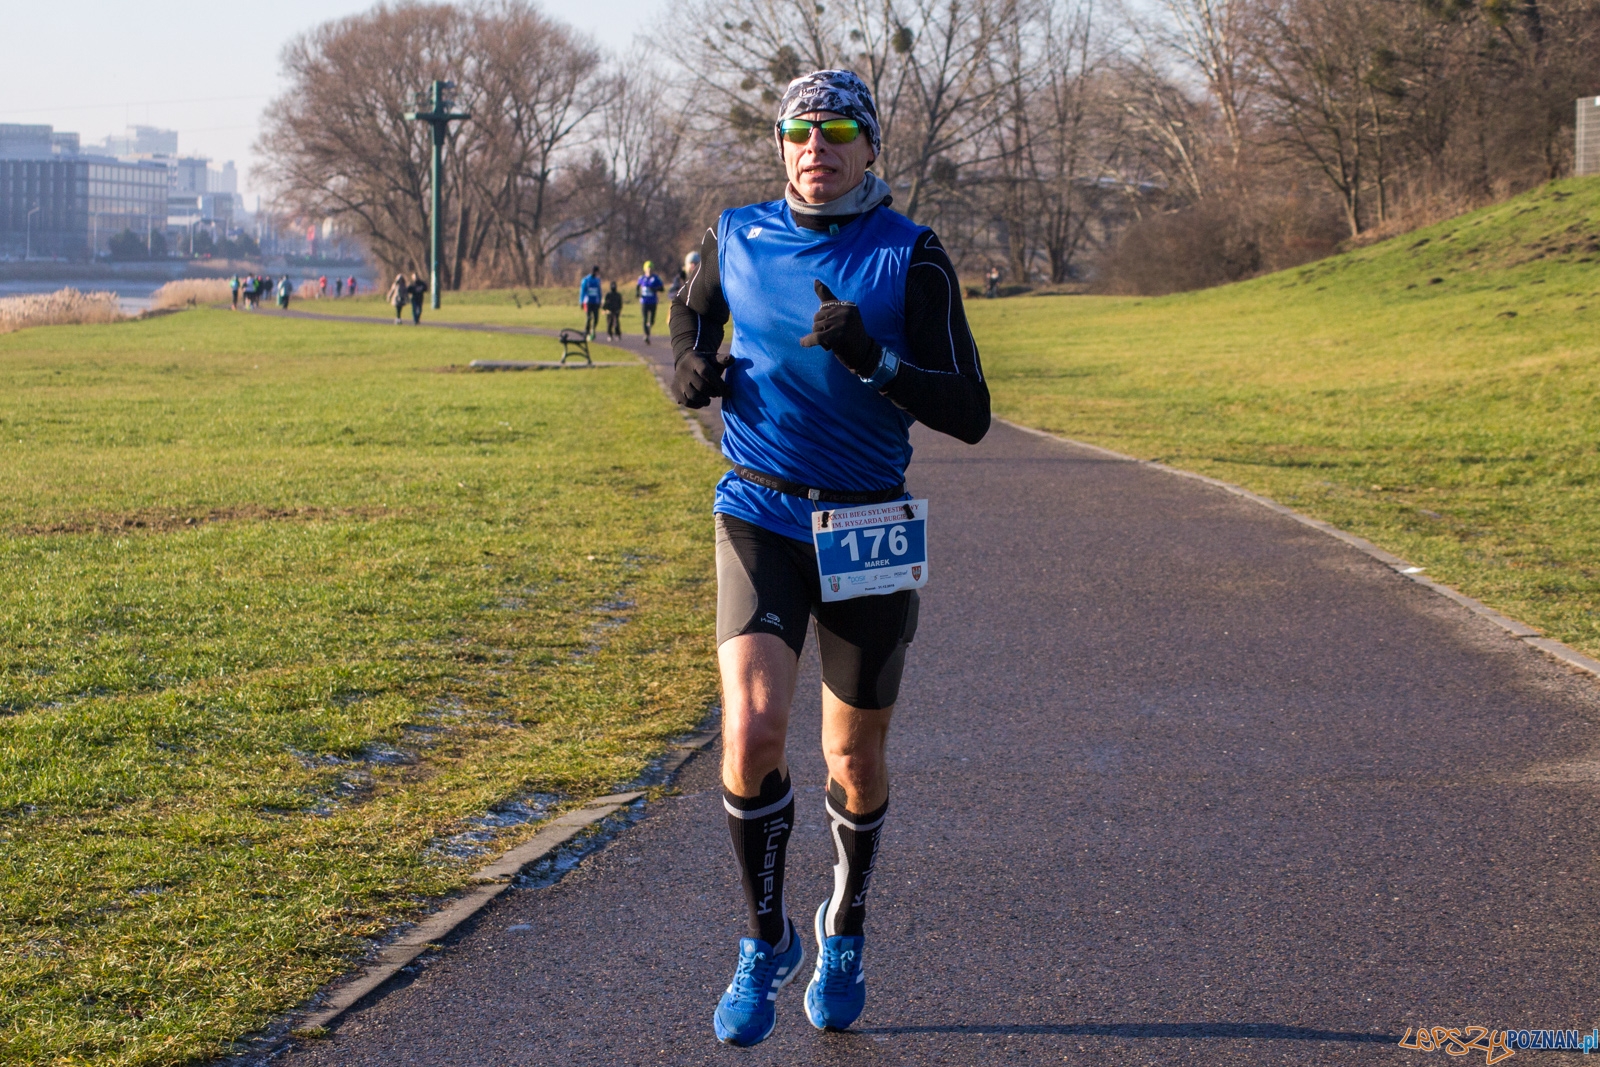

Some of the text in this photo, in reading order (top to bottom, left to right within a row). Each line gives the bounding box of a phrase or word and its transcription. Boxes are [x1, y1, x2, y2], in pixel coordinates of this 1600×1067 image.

[849, 510, 867, 519] BIEG
[867, 503, 920, 516] SYLWESTRWY
[832, 521, 844, 529] IM.
[845, 517, 883, 528] RYSZARDA
[840, 525, 909, 562] 176
[864, 558, 891, 568] MAREK
[757, 816, 789, 915] kalenji
